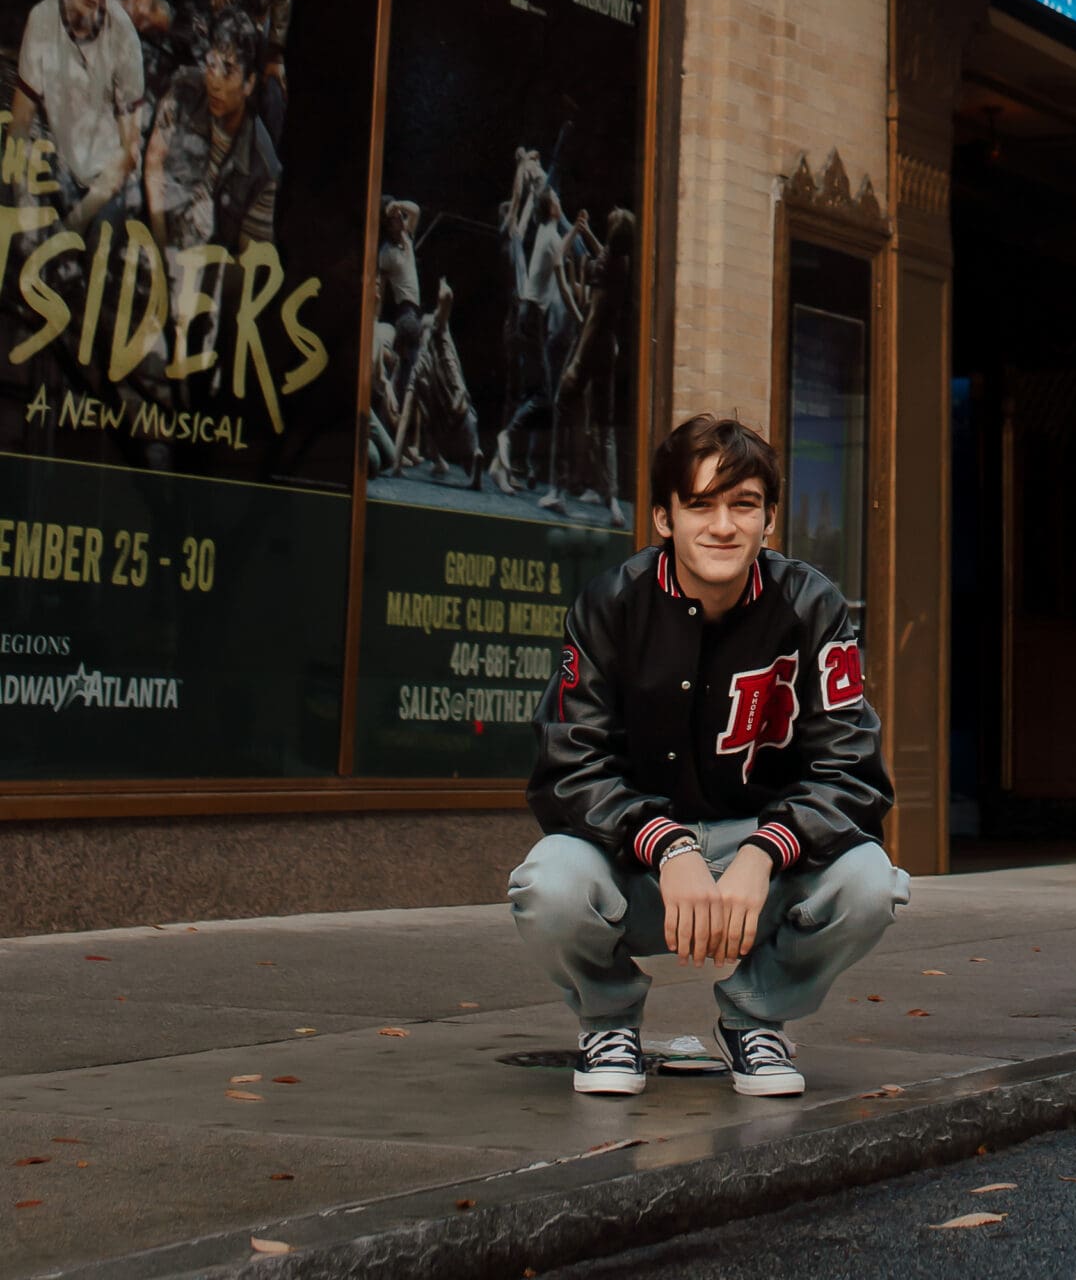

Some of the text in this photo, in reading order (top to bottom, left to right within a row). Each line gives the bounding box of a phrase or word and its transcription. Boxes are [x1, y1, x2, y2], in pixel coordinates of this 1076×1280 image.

[26, 384, 249, 451] A NEW MUSICAL
[111, 529, 150, 588] 25
[180, 536, 217, 593] 30
[444, 550, 562, 595] GROUP SALES &
[386, 591, 462, 635] MARQUEE
[466, 598, 505, 634] CLUB
[84, 669, 179, 709] ATLANTA
[746, 690, 760, 731] CHORUS
